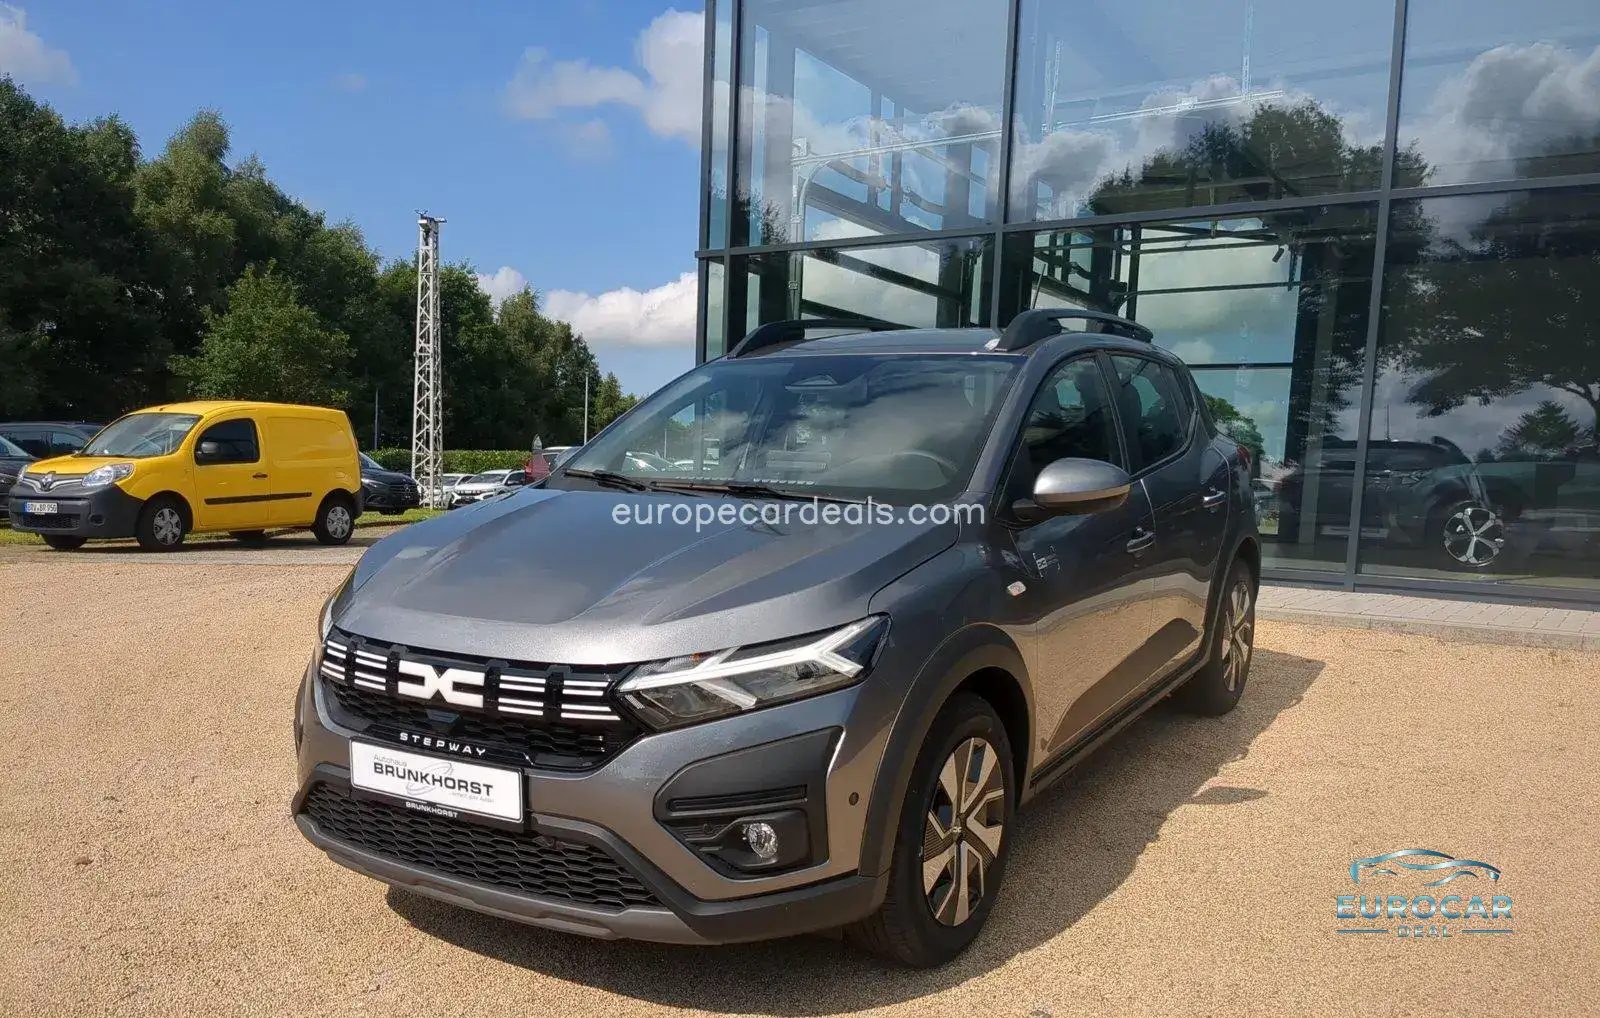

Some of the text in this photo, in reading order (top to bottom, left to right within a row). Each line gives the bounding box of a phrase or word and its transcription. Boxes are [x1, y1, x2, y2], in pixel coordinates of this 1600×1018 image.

[400, 732, 486, 756] STEPWAY
[374, 763, 494, 796] BRUNKHORST
[406, 802, 459, 819] BRUNKHORST
